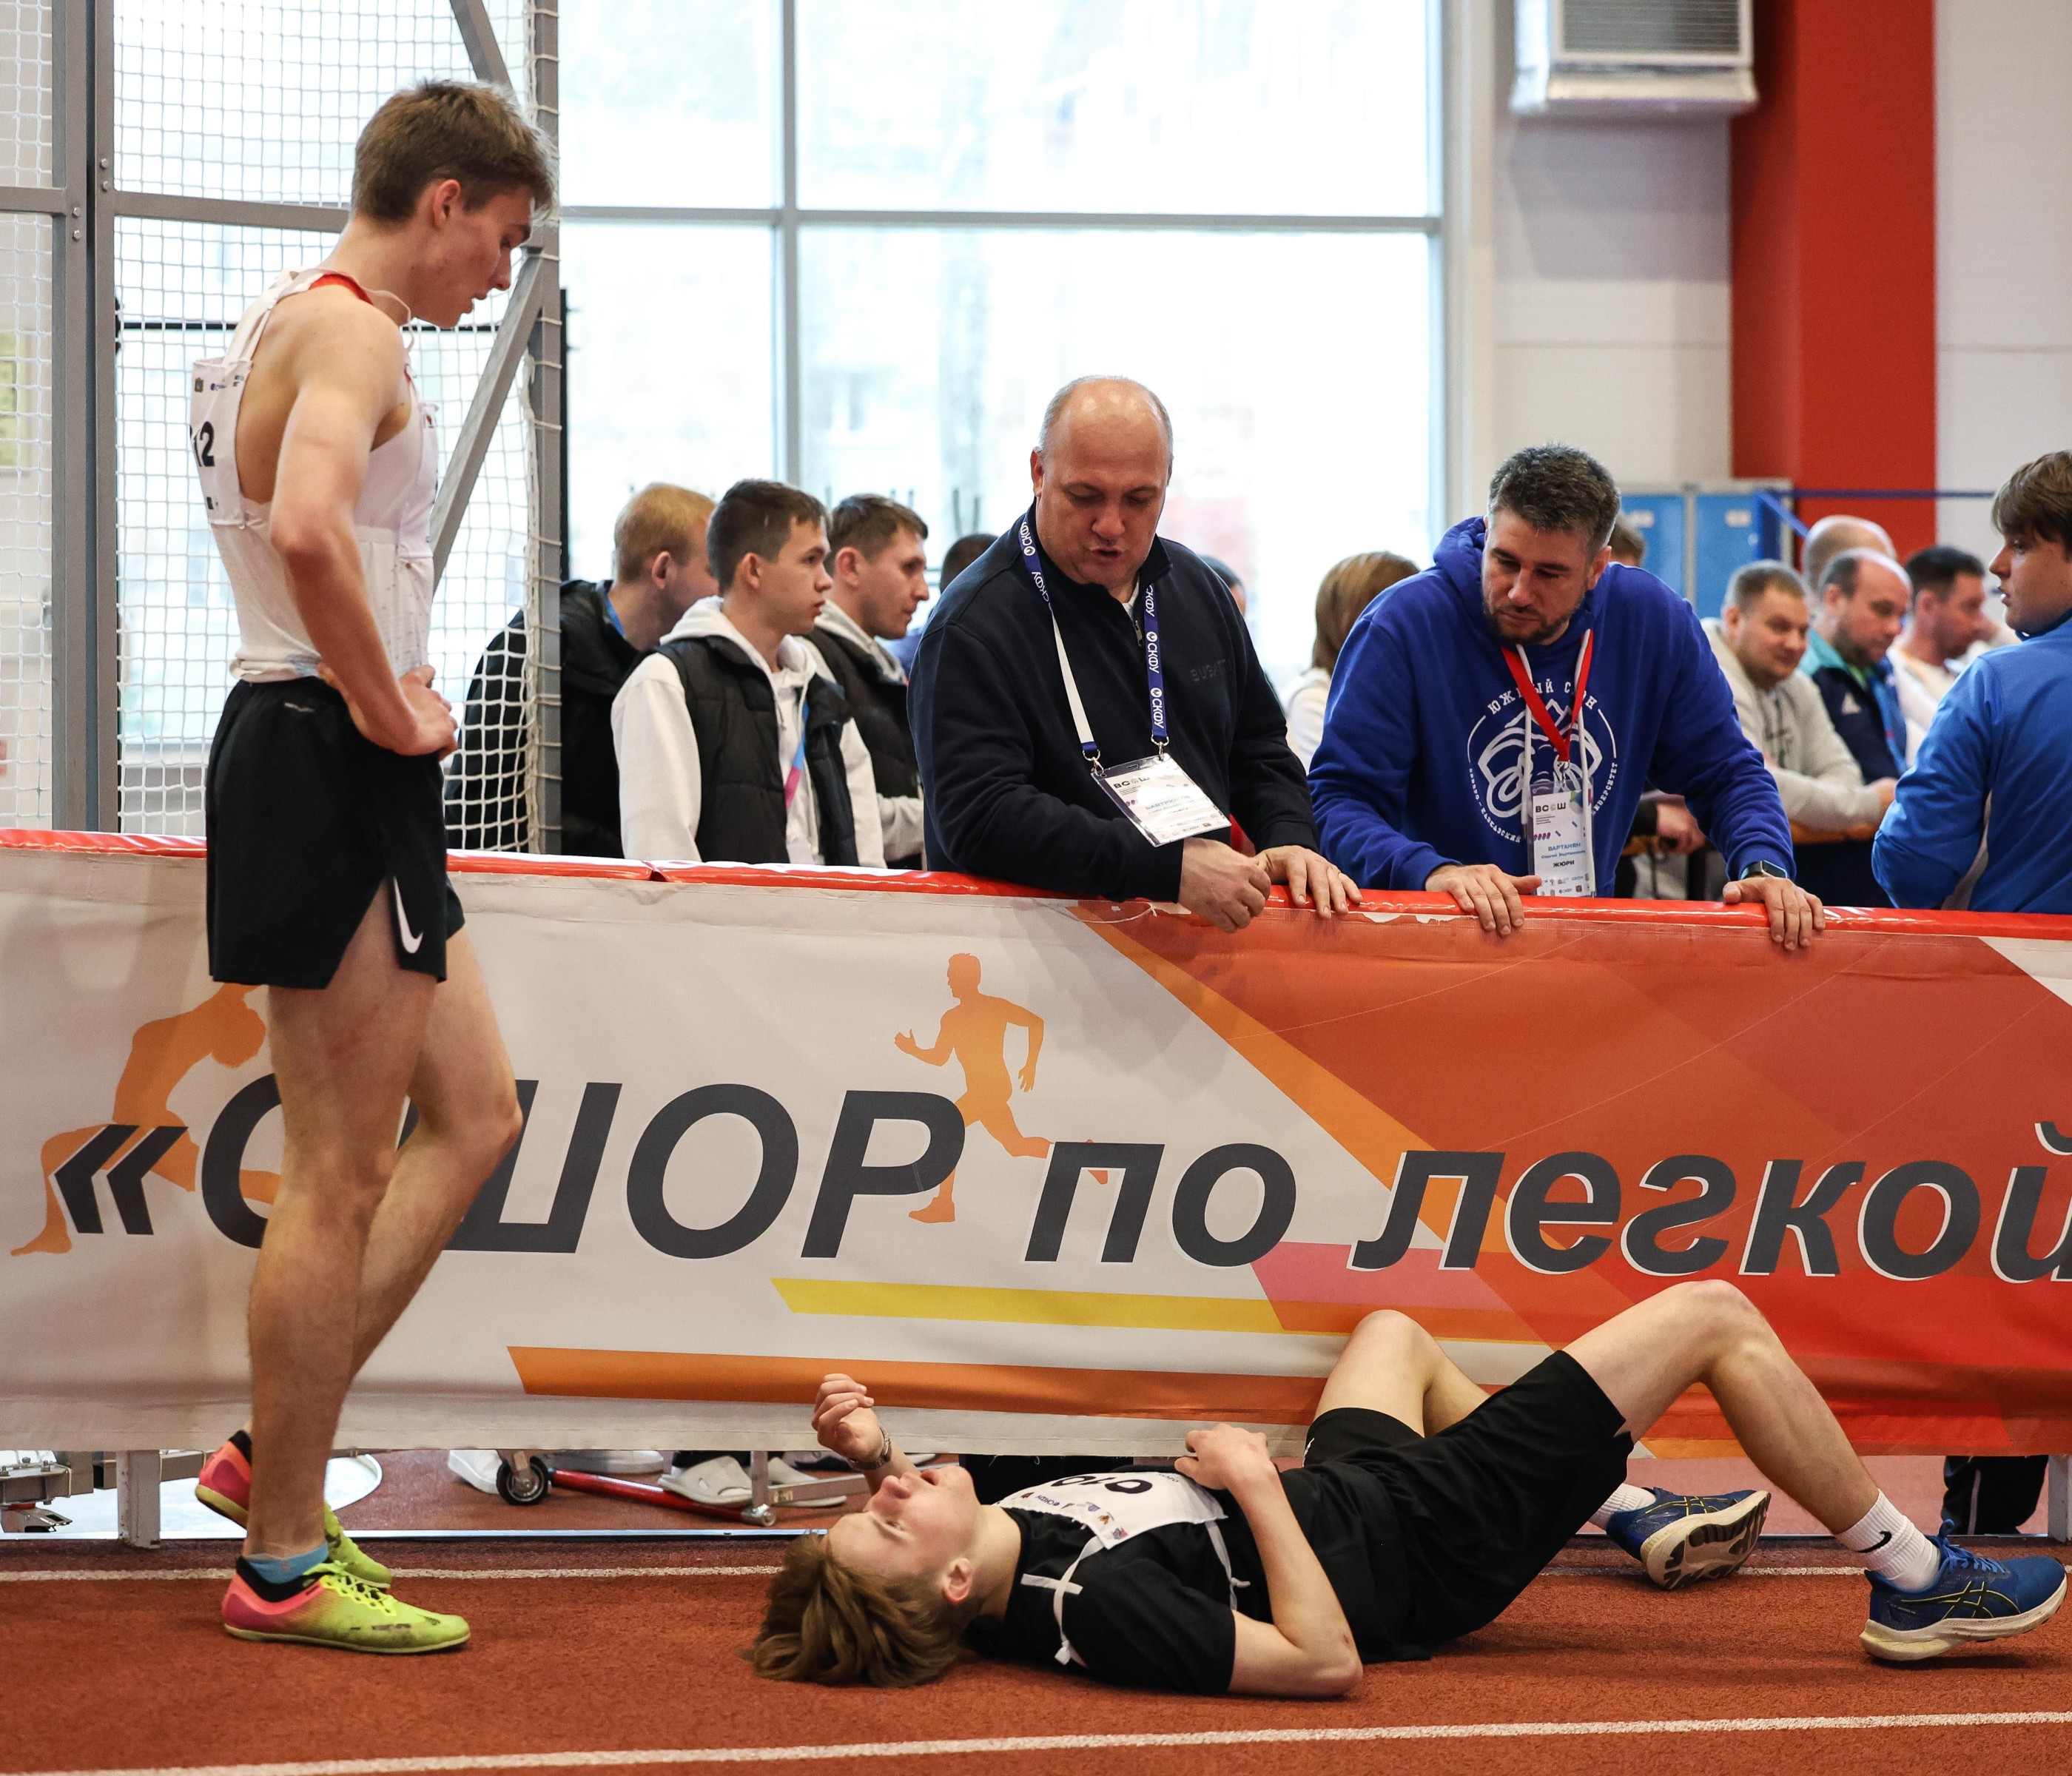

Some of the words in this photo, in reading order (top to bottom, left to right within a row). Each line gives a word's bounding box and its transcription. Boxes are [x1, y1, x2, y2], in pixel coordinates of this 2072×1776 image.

[1147, 642, 1160, 674] СКФУ
[1151, 698, 1165, 730] СКФУ
[1553, 860, 1575, 868] ЖЮРИ
[1023, 1141, 1297, 1268] по
[1346, 1120, 2072, 1283] легкой
